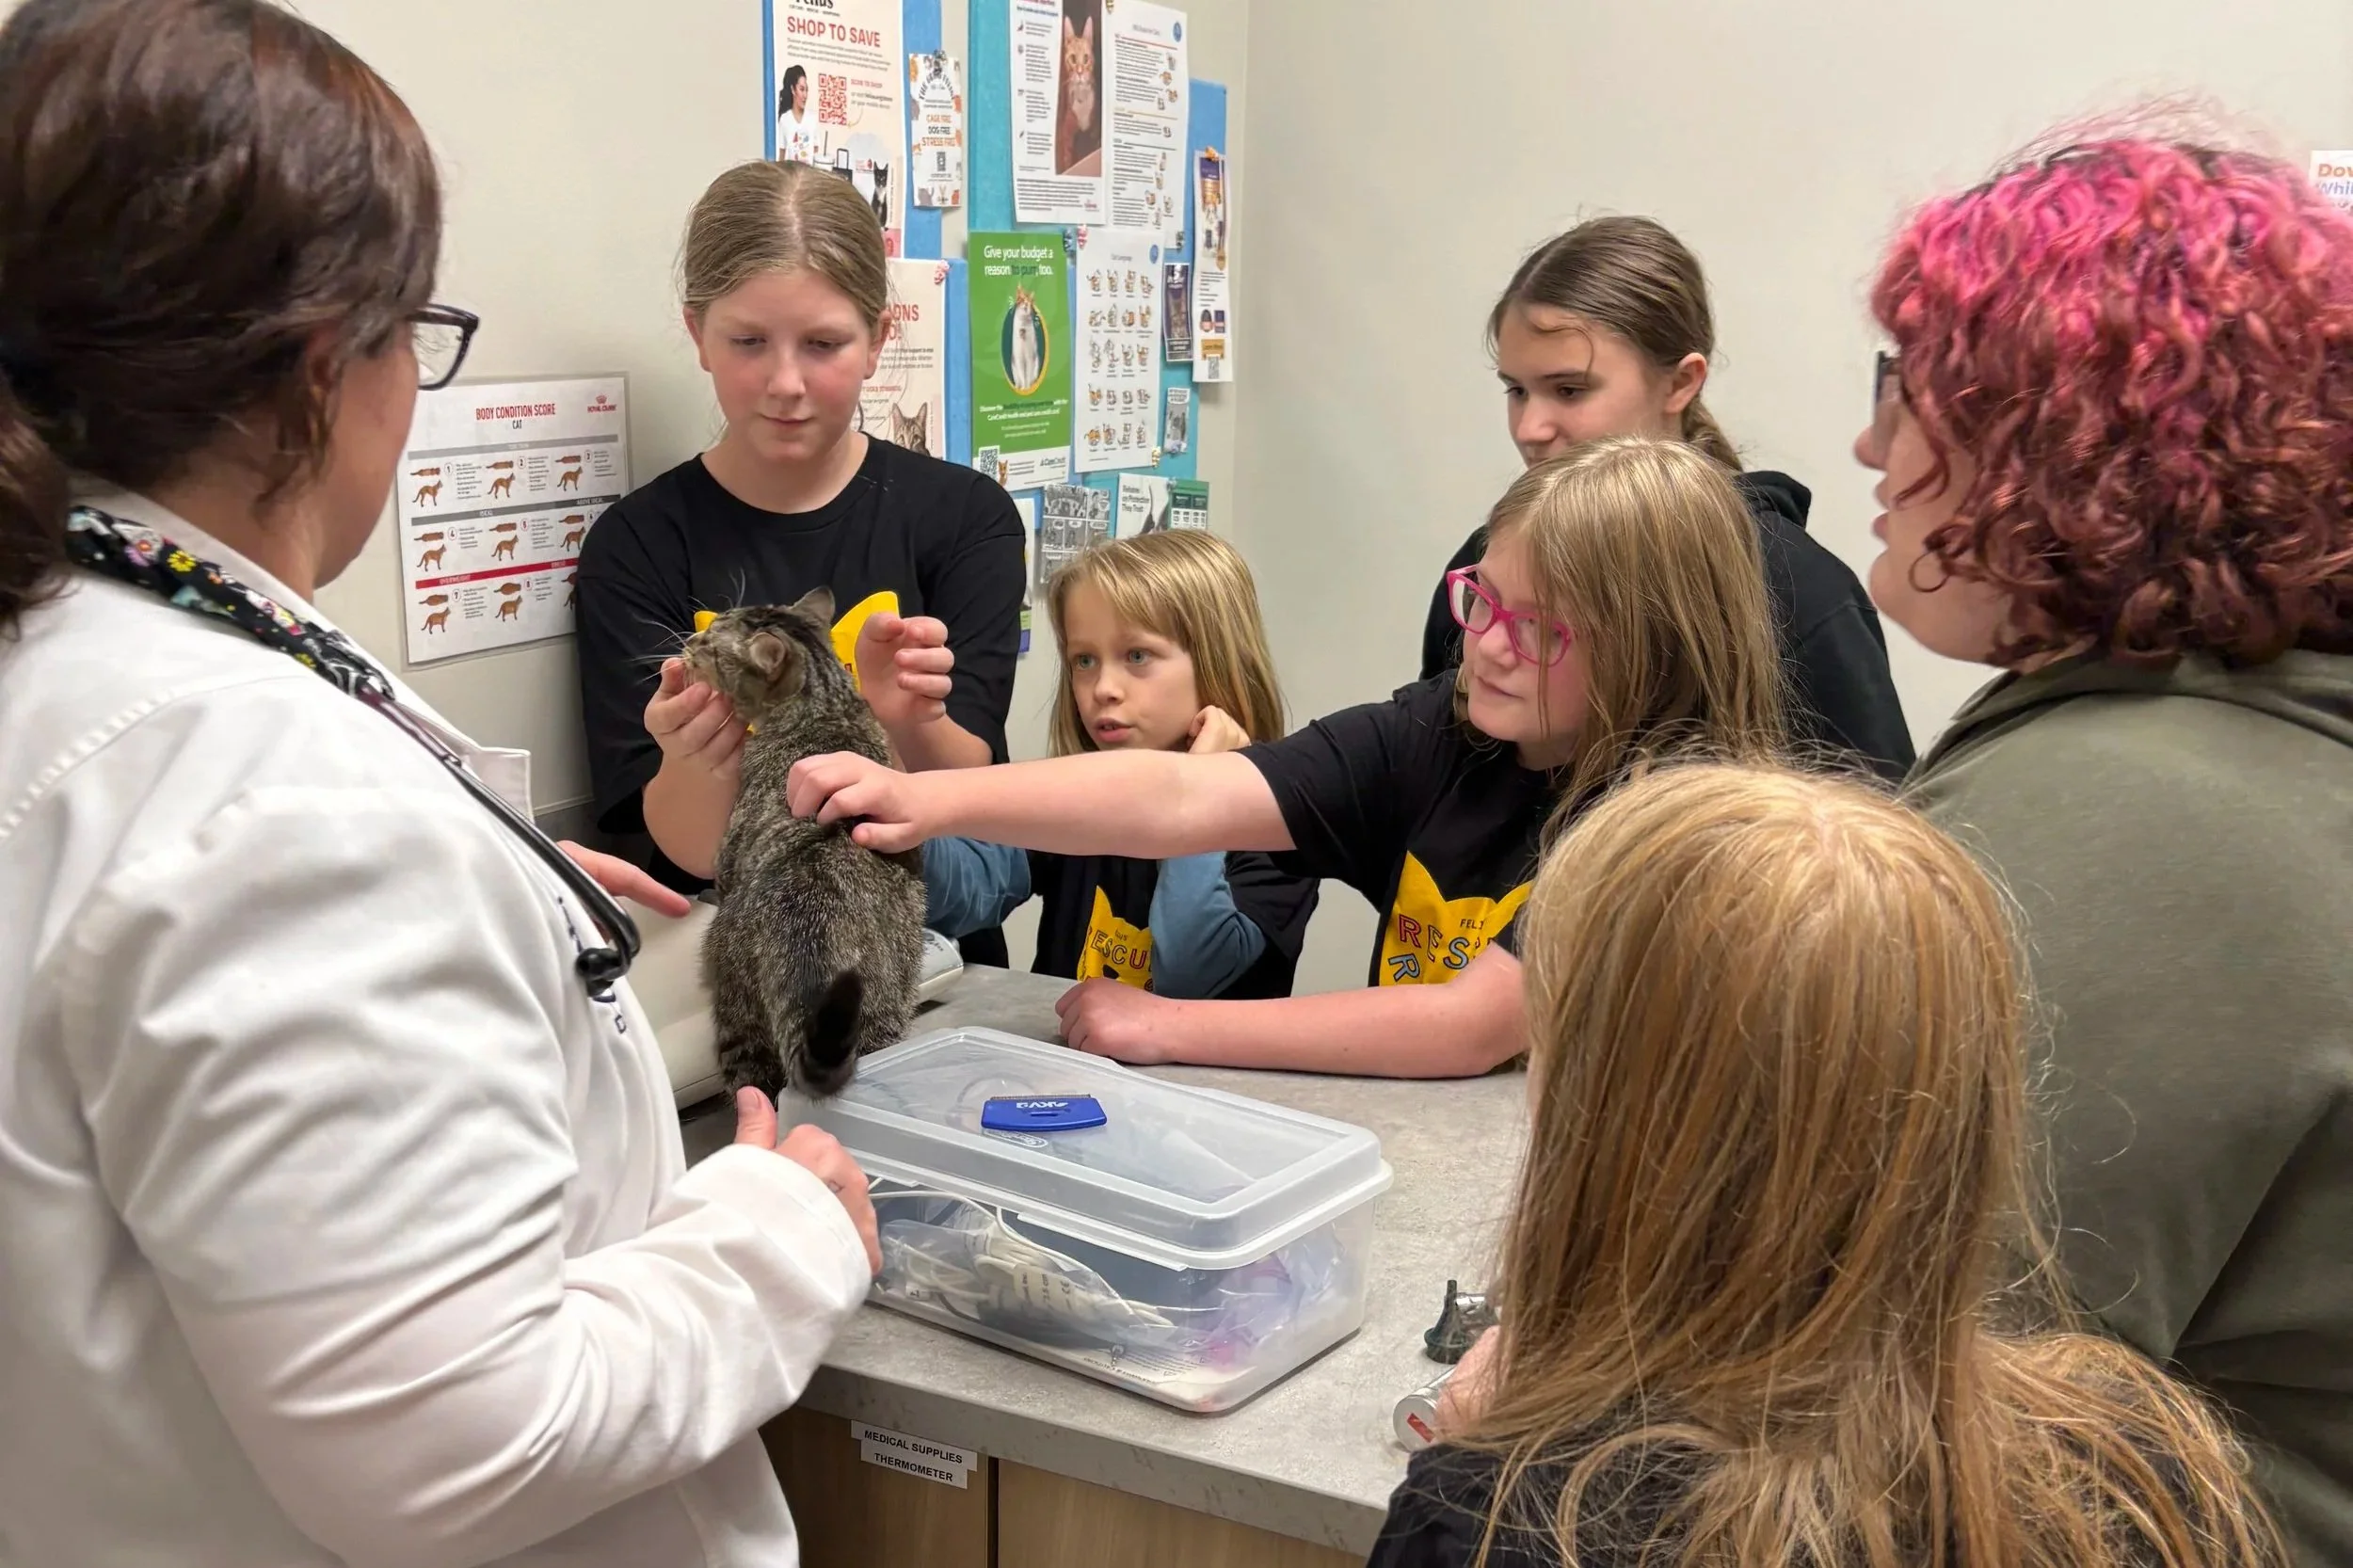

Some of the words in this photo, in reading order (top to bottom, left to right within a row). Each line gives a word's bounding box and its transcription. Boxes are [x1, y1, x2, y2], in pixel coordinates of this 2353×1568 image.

[787, 16, 825, 38] SHOP
[828, 23, 846, 41] TO
[849, 26, 881, 48] SAVE
[984, 245, 1001, 259] Give
[1002, 248, 1019, 262] your
[1020, 245, 1048, 262] budget
[1048, 248, 1054, 259] a
[984, 264, 1011, 276] reason
[475, 407, 494, 421] BODY
[495, 405, 533, 419] CONDITION
[534, 403, 556, 416] SCORE
[512, 420, 522, 430] CAT
[1090, 929, 1147, 970] ESCU
[1399, 913, 1470, 970] RES
[864, 1430, 909, 1450] MEDICAL
[911, 1443, 963, 1464] SUPPLIES
[873, 1452, 953, 1482] THERMOMETER
